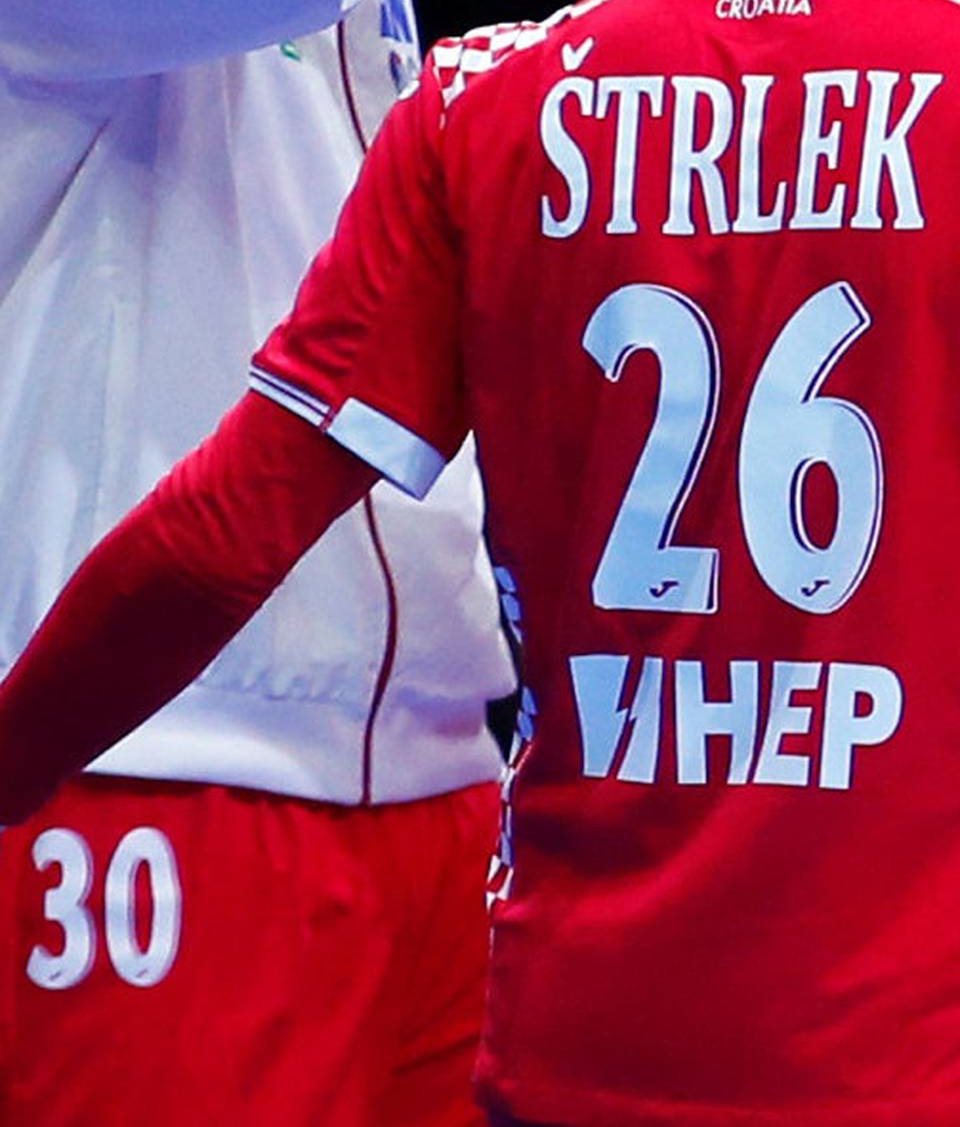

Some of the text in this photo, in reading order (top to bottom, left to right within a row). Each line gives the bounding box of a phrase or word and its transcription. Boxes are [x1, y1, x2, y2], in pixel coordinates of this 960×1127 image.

[540, 38, 944, 238] ŠTRLEK
[582, 280, 886, 615] 26
[675, 659, 905, 790] HEP
[27, 826, 182, 990] 30
